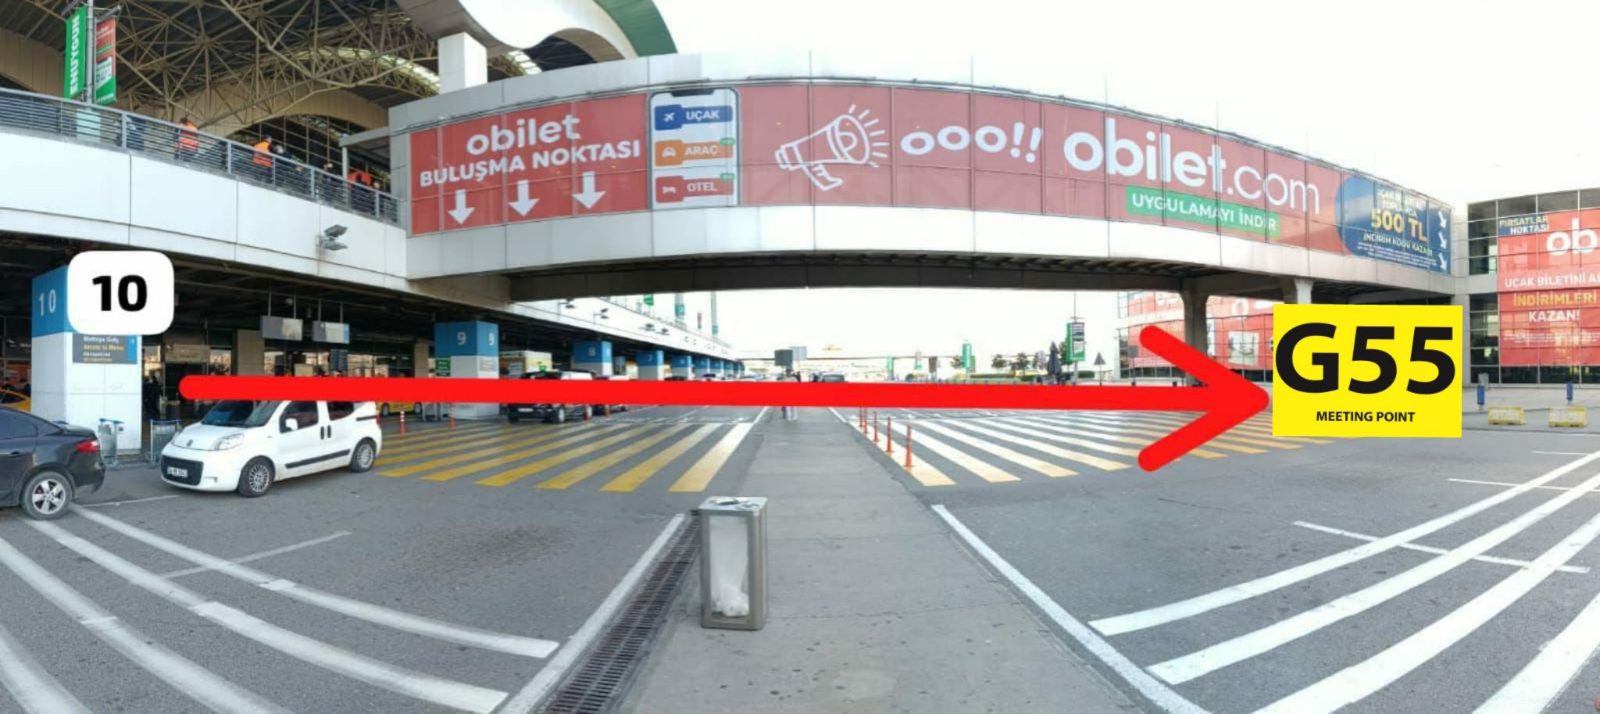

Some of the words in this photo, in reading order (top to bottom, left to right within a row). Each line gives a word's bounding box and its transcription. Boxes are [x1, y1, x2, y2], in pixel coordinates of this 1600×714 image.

[685, 110, 720, 121] UÇAK
[467, 113, 581, 156] obilet
[900, 122, 1043, 163] ooo!!
[420, 156, 525, 187] BULUŞMA
[532, 140, 641, 169] NOKTASI
[1063, 118, 1320, 215] obilet.com
[686, 182, 718, 192] OTEL
[1132, 193, 1234, 223] UYGULAMAYI
[1371, 207, 1404, 234] 500
[1408, 216, 1428, 244] TL
[1504, 277, 1535, 288] UÇAK
[38, 289, 57, 317] 10
[1528, 309, 1580, 322] KAZAN!
[457, 331, 466, 346] 9
[488, 332, 495, 346] 9
